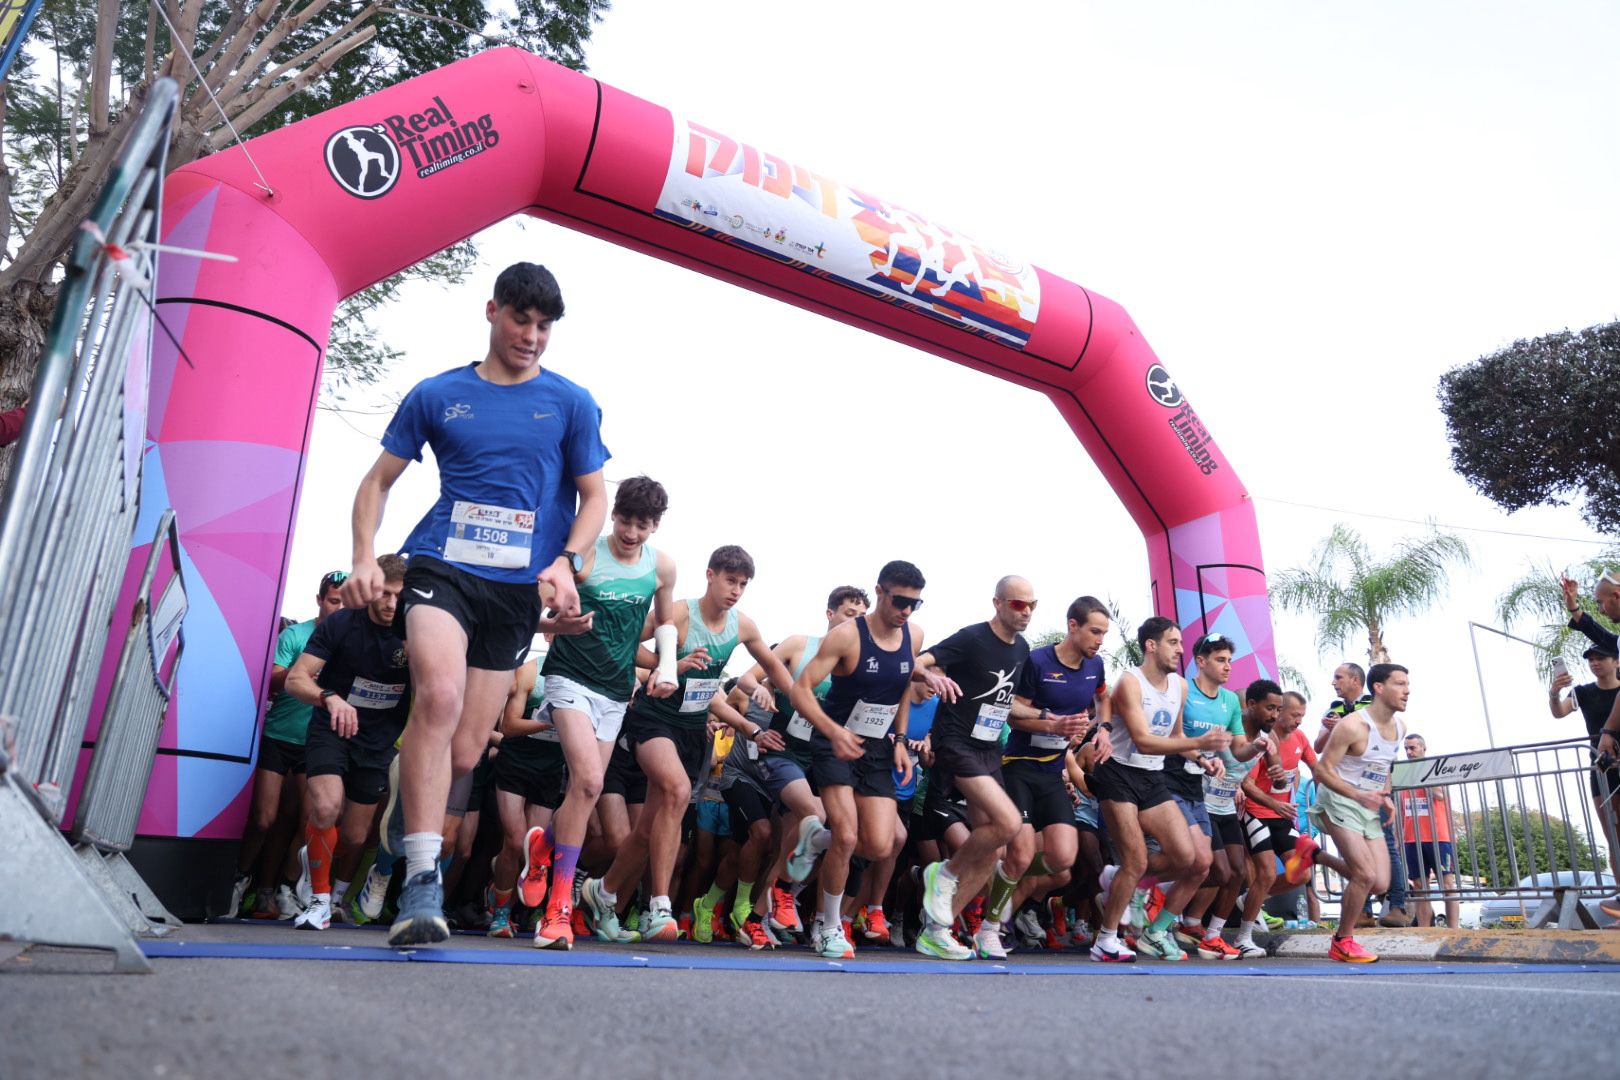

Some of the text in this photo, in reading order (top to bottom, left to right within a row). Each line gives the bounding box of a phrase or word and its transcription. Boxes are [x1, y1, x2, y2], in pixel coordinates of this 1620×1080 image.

[383, 96, 455, 141] Real
[400, 113, 500, 169] Timing
[419, 143, 484, 178] realtiming.co.il
[1181, 402, 1213, 445] Real
[1172, 411, 1219, 476] Timing
[473, 527, 509, 544] 1508
[864, 716, 885, 726] 1925
[1420, 757, 1482, 783] New age
